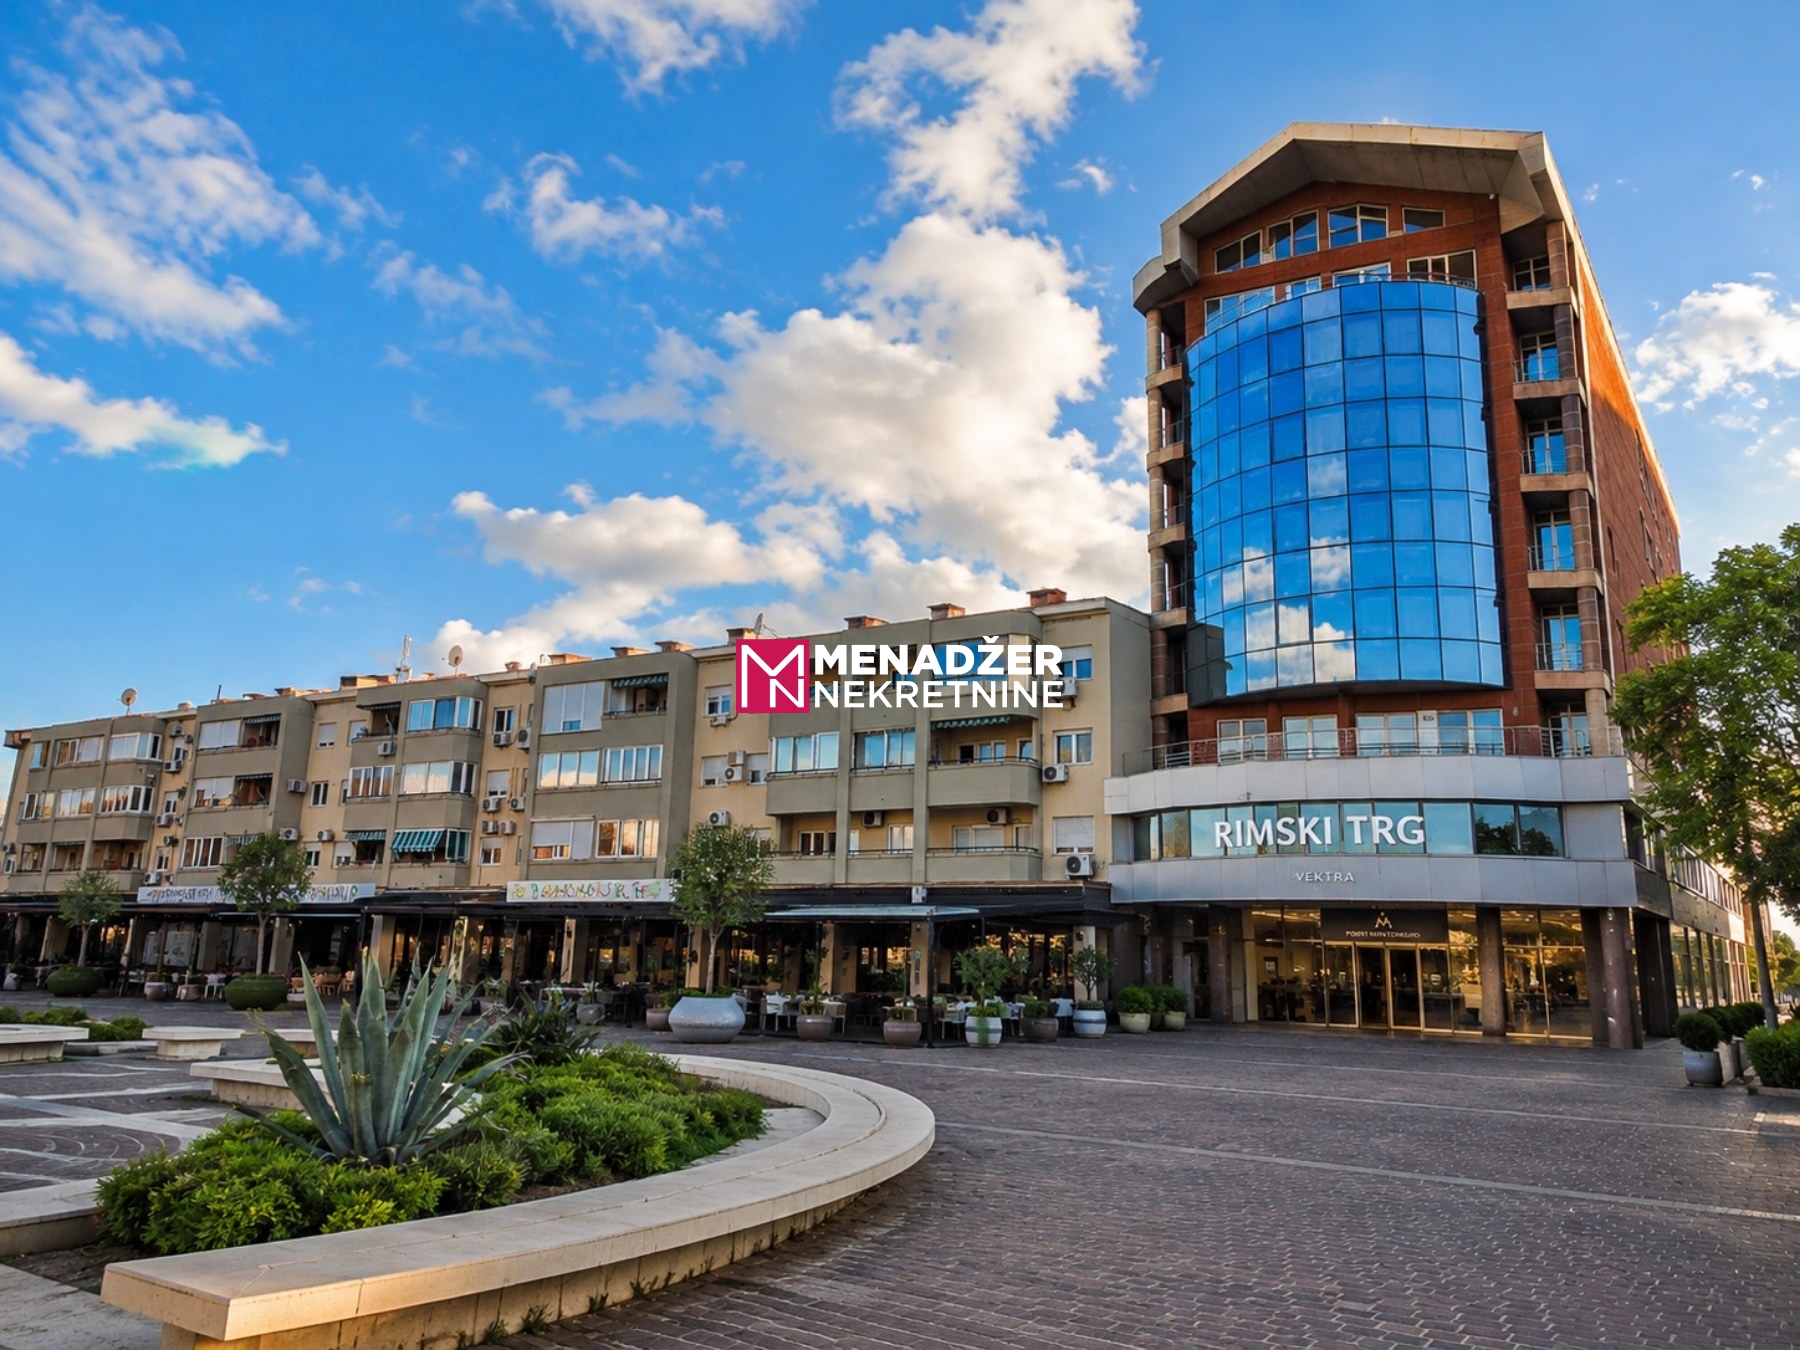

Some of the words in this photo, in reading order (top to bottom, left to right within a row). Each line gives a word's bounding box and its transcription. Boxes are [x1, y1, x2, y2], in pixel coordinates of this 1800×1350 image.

[1214, 815, 1332, 849] RIMSKI
[1346, 815, 1425, 845] TRG
[1295, 871, 1356, 883] VEKTRA
